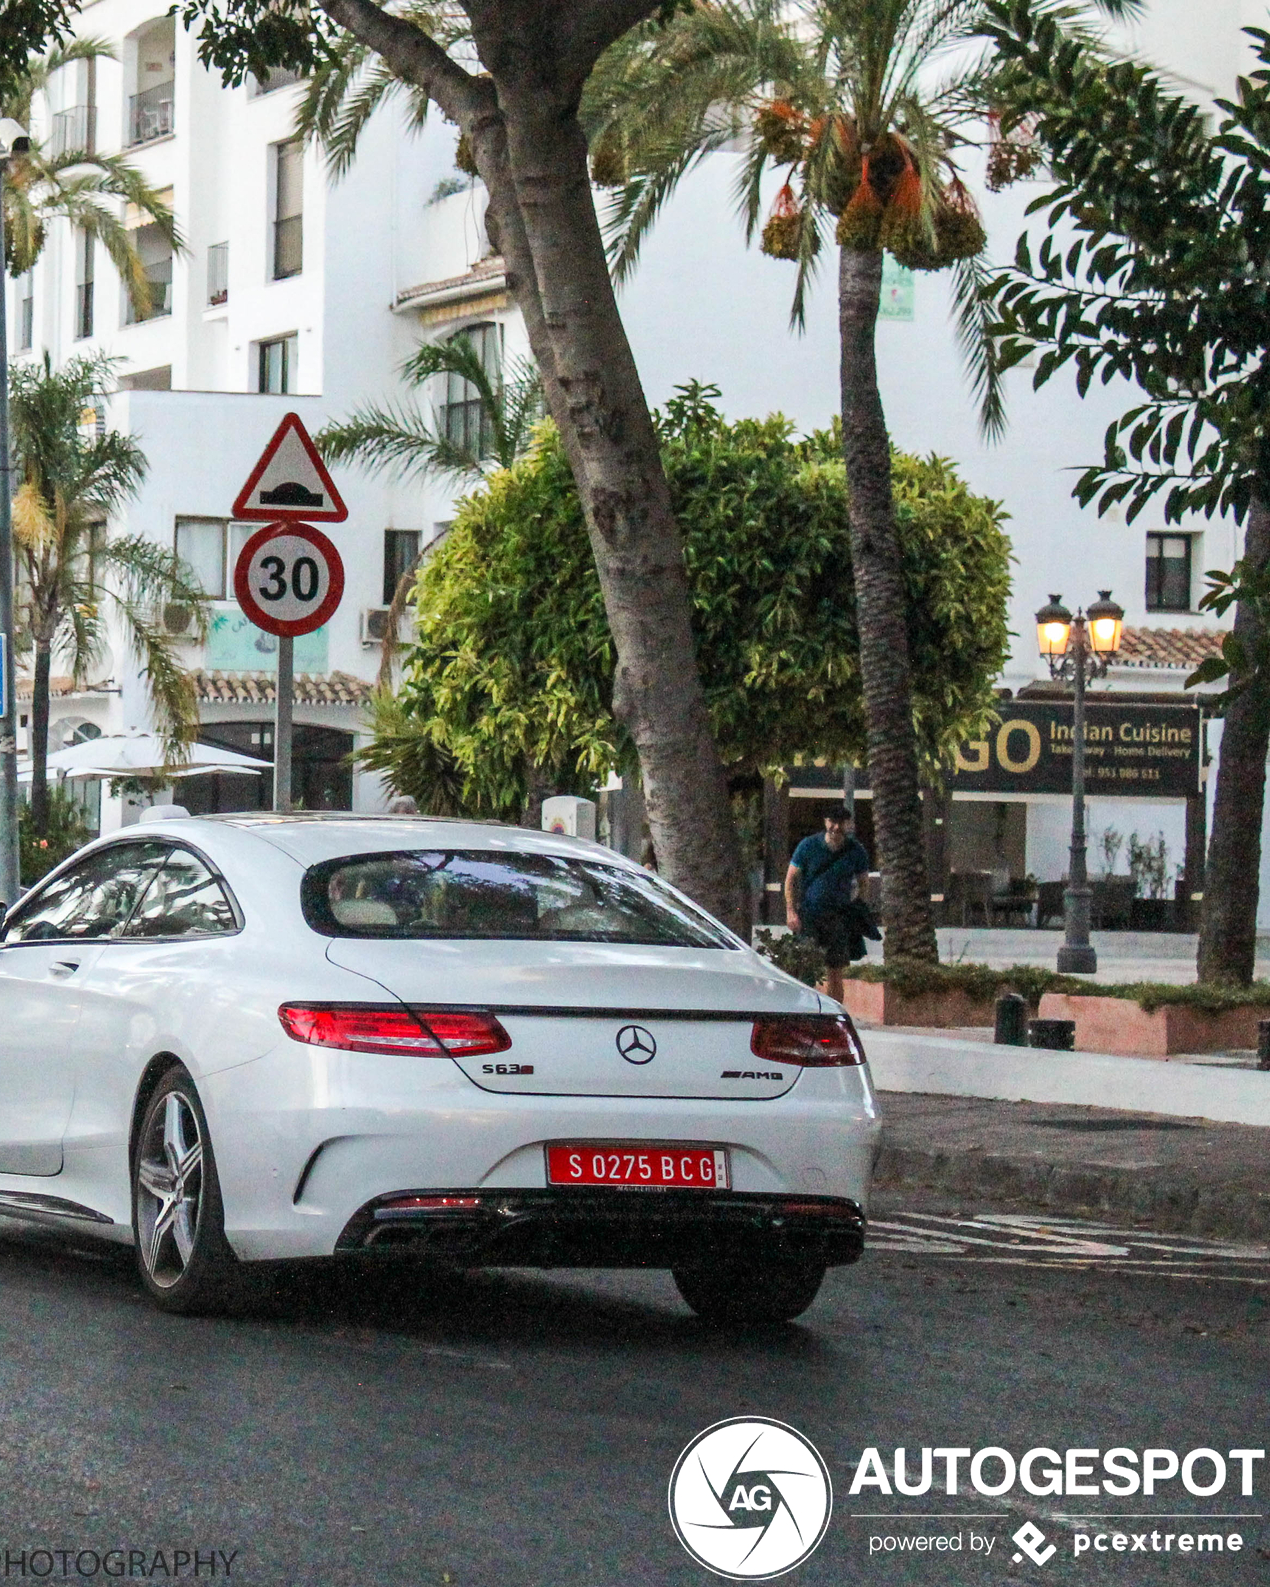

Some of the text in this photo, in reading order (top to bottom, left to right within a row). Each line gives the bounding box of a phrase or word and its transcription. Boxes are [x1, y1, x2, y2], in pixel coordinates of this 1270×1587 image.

[259, 555, 319, 602] 30
[1119, 722, 1193, 743] Cuisine
[1114, 746, 1145, 756] Home
[1147, 747, 1192, 759] Delivery
[569, 1154, 582, 1178] S
[592, 1155, 652, 1179] 0275
[661, 1156, 713, 1181] BCG
